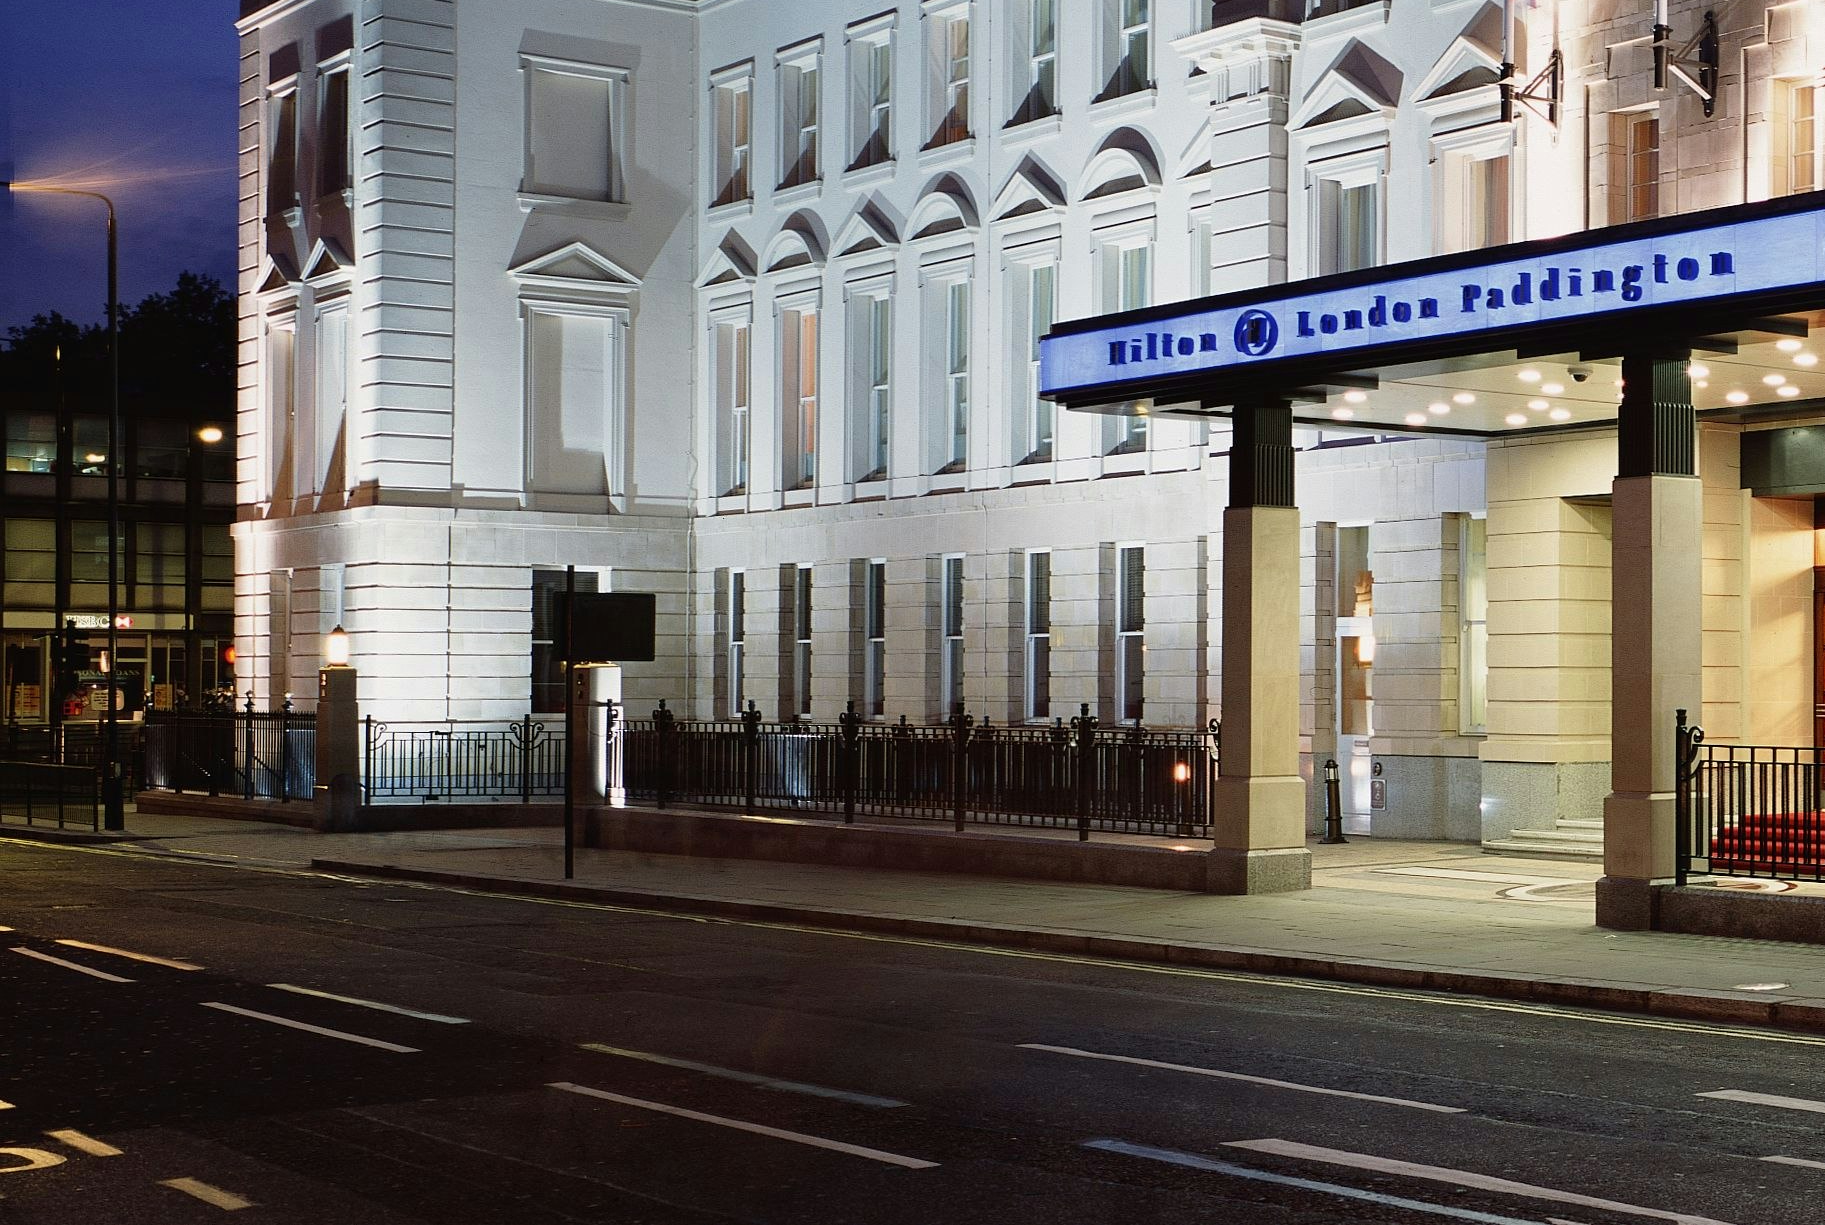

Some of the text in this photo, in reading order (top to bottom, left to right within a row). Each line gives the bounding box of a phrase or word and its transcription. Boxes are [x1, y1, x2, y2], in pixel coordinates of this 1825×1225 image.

[1108, 251, 1735, 365] Hilton London Paddington
